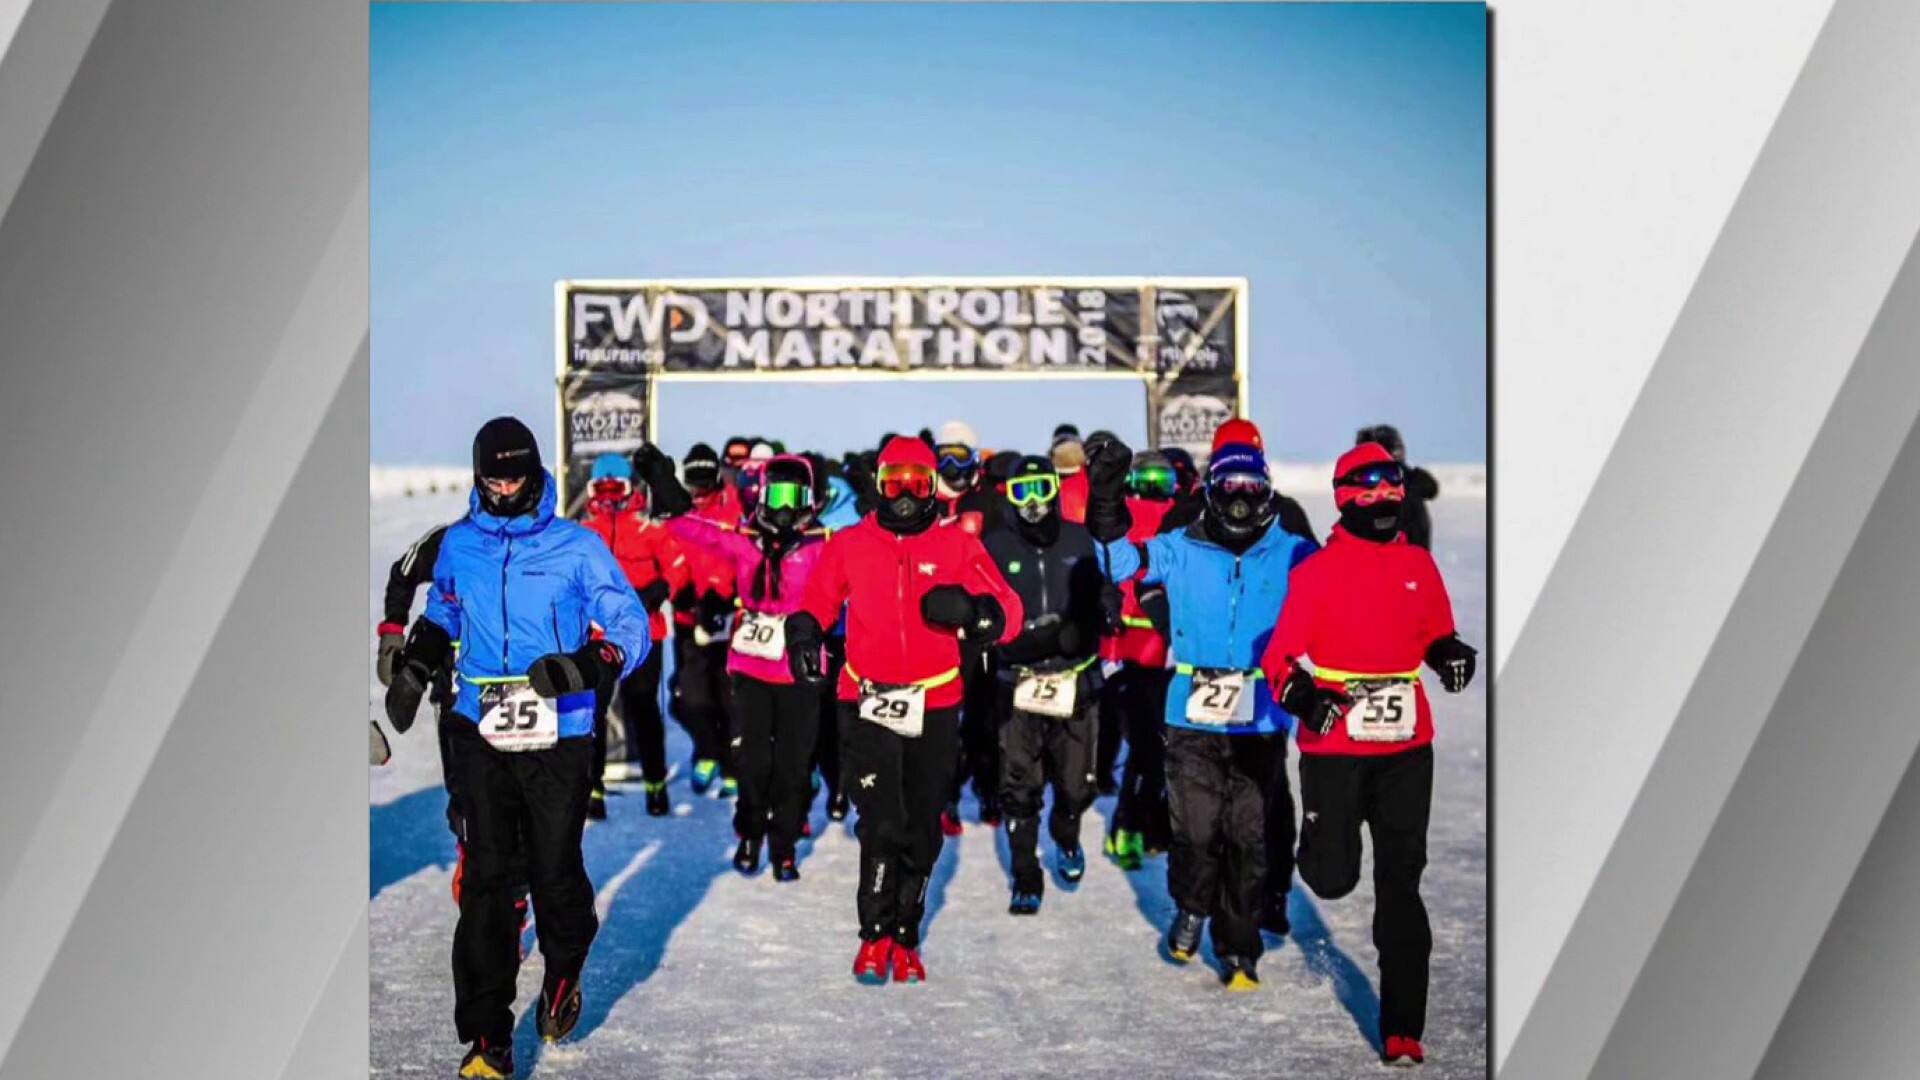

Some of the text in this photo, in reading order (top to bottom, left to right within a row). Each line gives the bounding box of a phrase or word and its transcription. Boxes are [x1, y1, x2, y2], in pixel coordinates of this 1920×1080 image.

[574, 293, 708, 342] FWD
[725, 289, 1065, 326] NORTH POLE
[1078, 290, 1105, 367] 2018
[574, 343, 664, 362] insurance
[723, 328, 1069, 367] MARATHON
[744, 623, 774, 643] 30
[1033, 679, 1061, 699] 15
[1202, 680, 1240, 709] 27
[495, 701, 538, 731] 35
[872, 696, 909, 718] 29
[1363, 695, 1402, 723] 55
